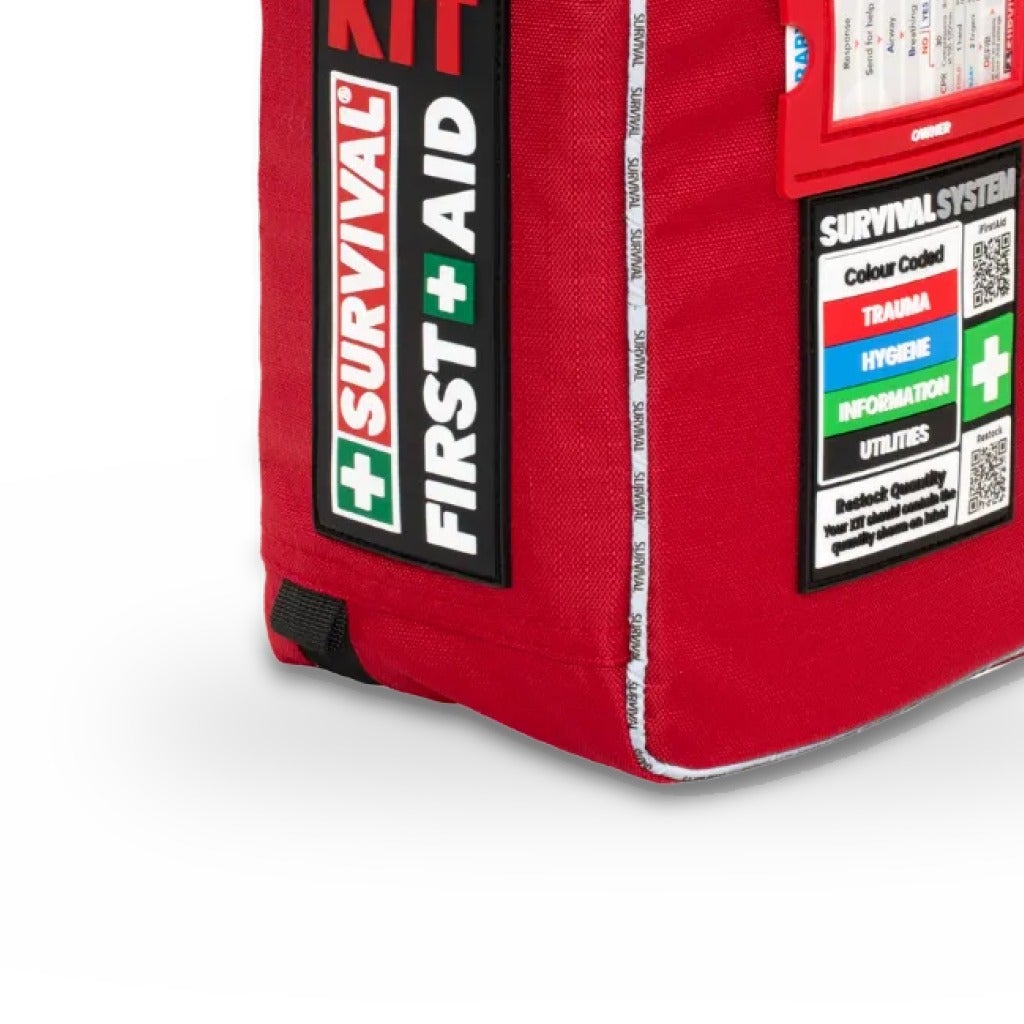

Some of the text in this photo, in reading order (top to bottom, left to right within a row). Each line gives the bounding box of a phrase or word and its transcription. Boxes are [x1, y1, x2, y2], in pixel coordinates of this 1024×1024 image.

[842, 17, 851, 70] Response
[865, 2, 875, 76] Send for help
[886, 16, 897, 53] Airway
[908, 4, 919, 57] Breathing
[921, 1, 929, 55] NO YES
[844, 244, 944, 286] Colour Coded
[421, 95, 478, 556] FIRST AID
[861, 291, 932, 327] TRAUMA
[861, 336, 932, 373] HYGIENE
[838, 374, 950, 423] INFORMATION
[859, 423, 930, 460] UTILITIES
